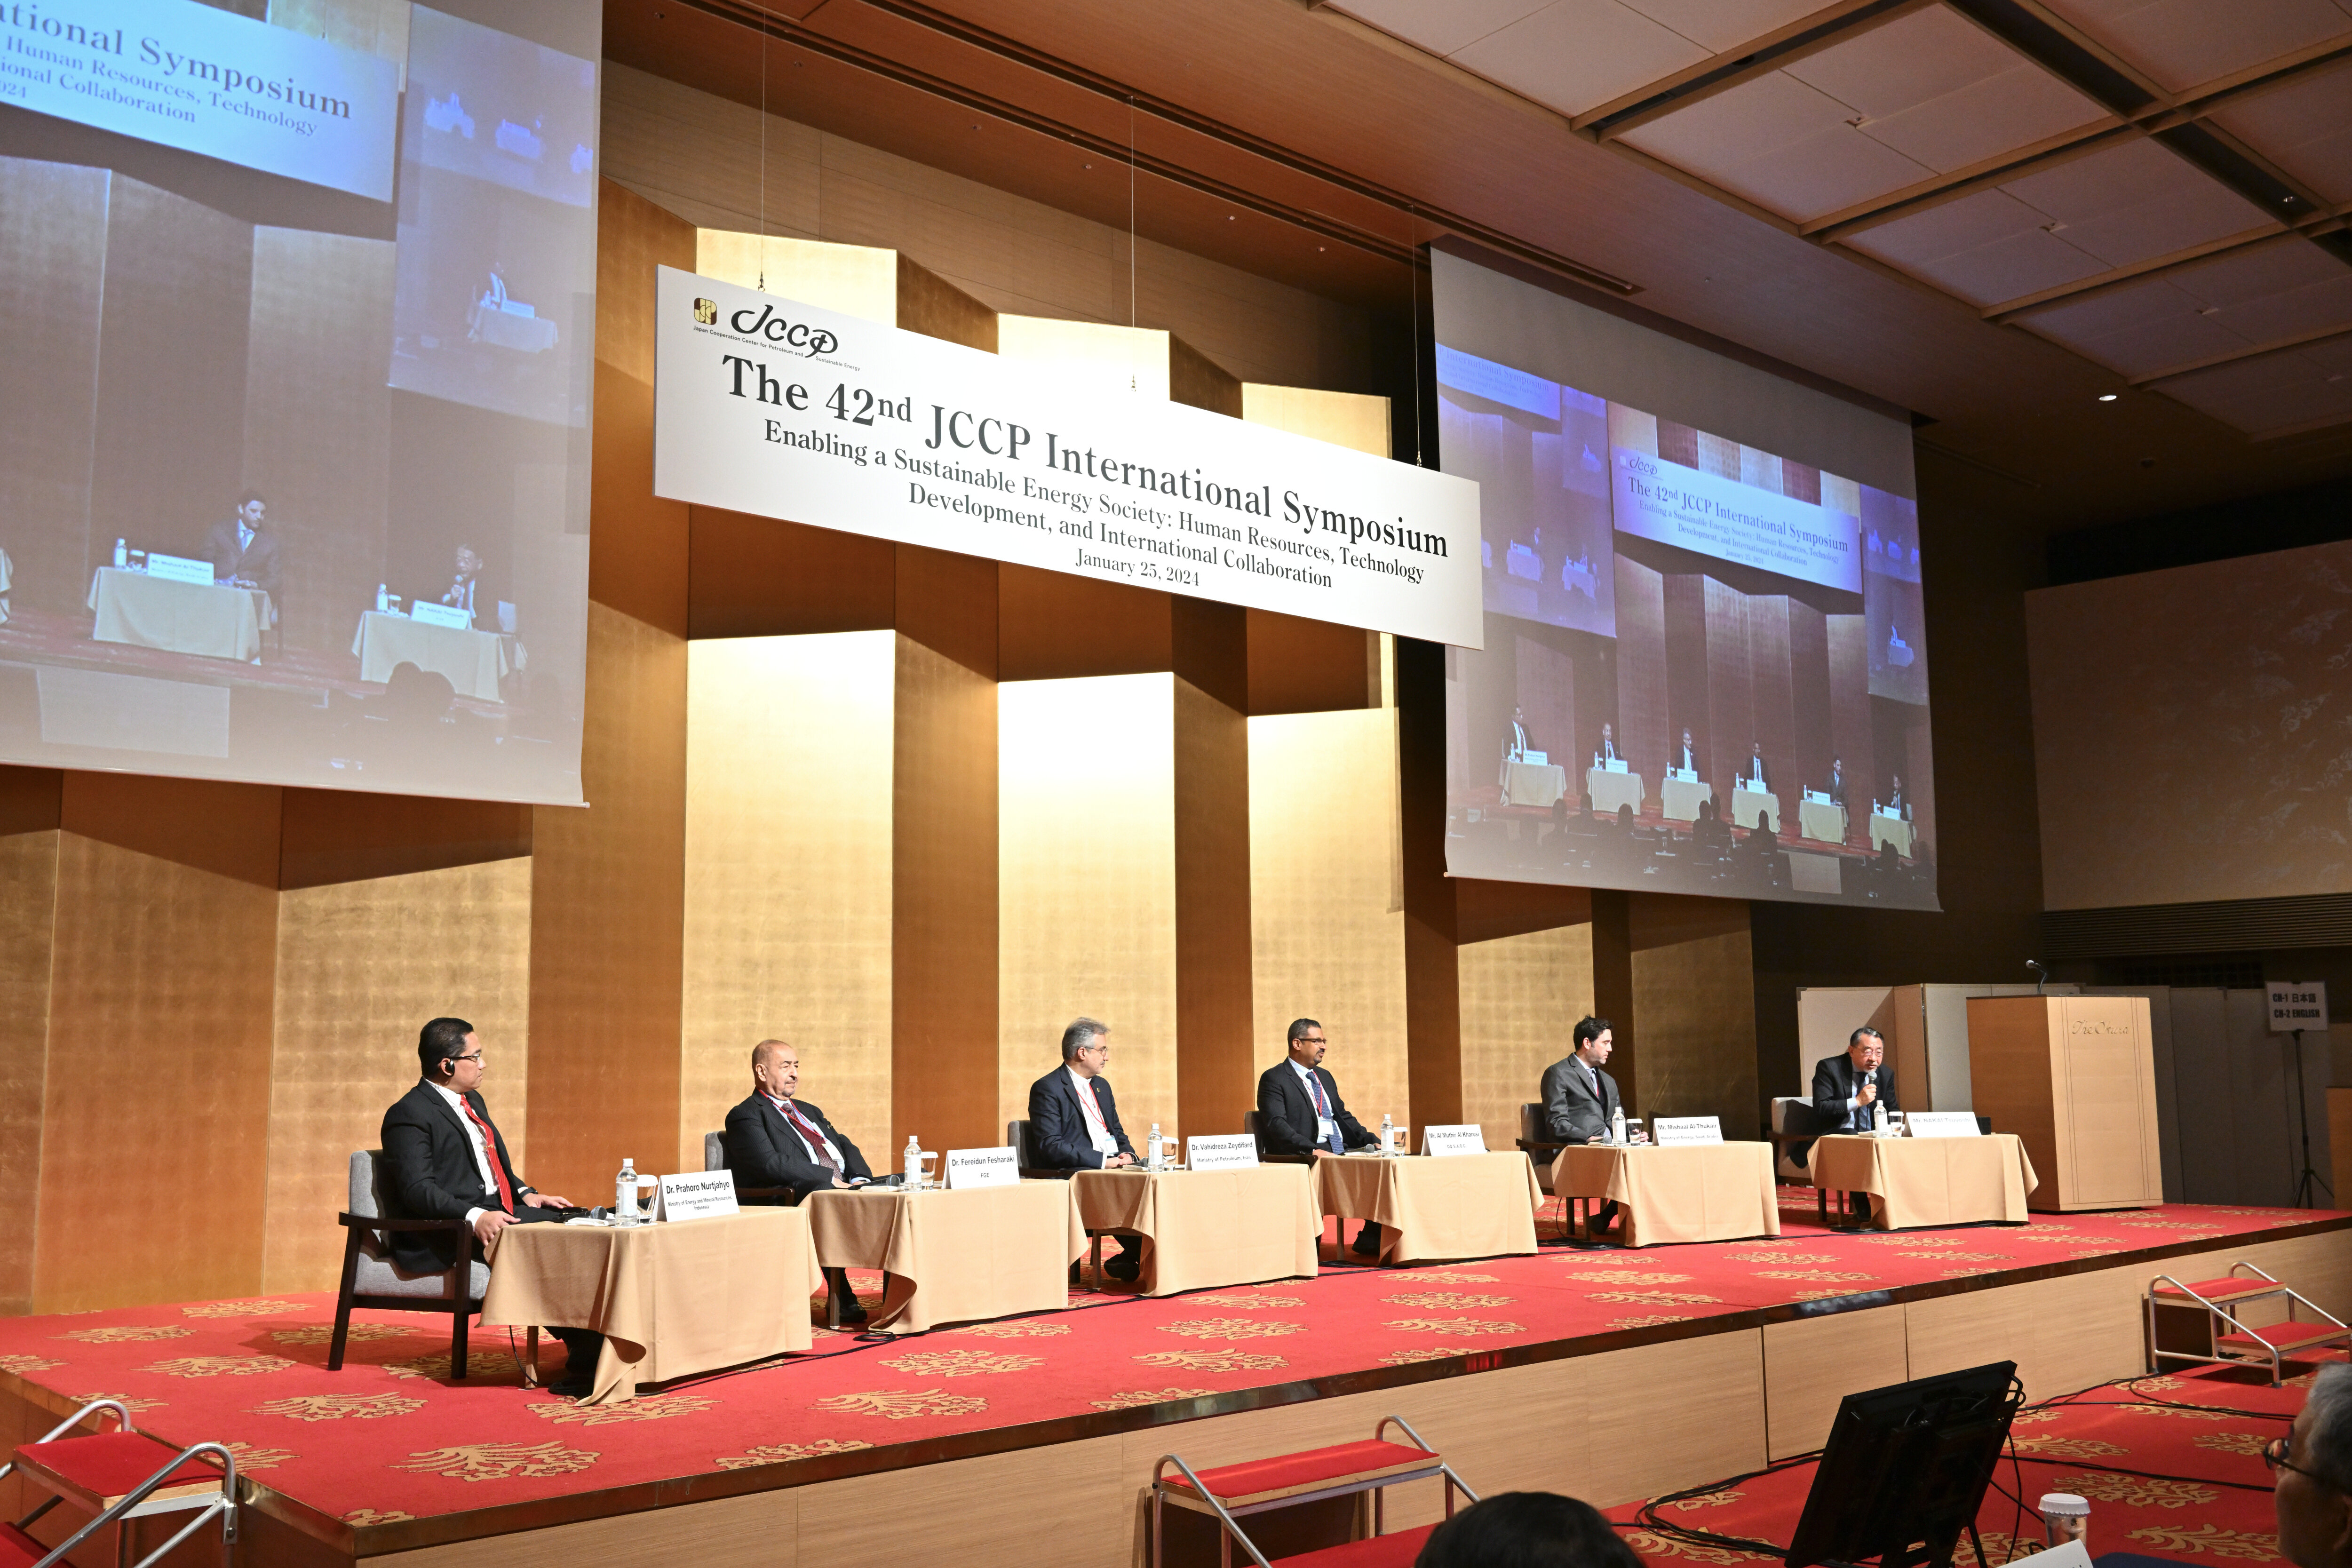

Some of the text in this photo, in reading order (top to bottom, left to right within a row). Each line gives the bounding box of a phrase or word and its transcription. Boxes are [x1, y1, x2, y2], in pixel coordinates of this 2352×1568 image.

[7, 36, 317, 136] Human Resources, Technology
[59, 73, 195, 122] Collaboration
[140, 38, 350, 119] Symposium
[693, 325, 708, 334] Japan
[710, 329, 740, 341] Cooperation
[742, 337, 758, 346] Center
[769, 344, 793, 354] Petroleum
[816, 356, 843, 366] Sustainable
[844, 363, 860, 372] Energy
[1504, 369, 1549, 392] Symposium
[722, 354, 1448, 557] The 42nd JCCP International Symposium
[764, 419, 1424, 584] Enabling a Sustainable Energy Society: Human Resources, Technology
[1628, 476, 1848, 552] The 42nd JCCP International Symposium
[909, 482, 1332, 588] Development, and International Collaboration
[1639, 500, 1667, 517] Enabling
[1674, 509, 1708, 527] Sustainable
[1709, 520, 1730, 534] Energy
[1756, 533, 1777, 546] Human
[1778, 539, 1808, 555] Resources,
[1809, 548, 1840, 565] Technology
[1678, 523, 1808, 566] Development, and International Collaboration
[1725, 548, 1744, 559] January
[1075, 548, 1199, 586] January 25, 2024
[2273, 993, 2316, 1003] CH-1 日本語
[2274, 1009, 2320, 1018] CH-2 ENGLISH
[2072, 1020, 2093, 1035] The
[987, 1155, 1015, 1164] Fesharaki
[1228, 1142, 1253, 1150] Zeydifard
[666, 1180, 730, 1194] Dr. Prahoro Nurtjahyo
